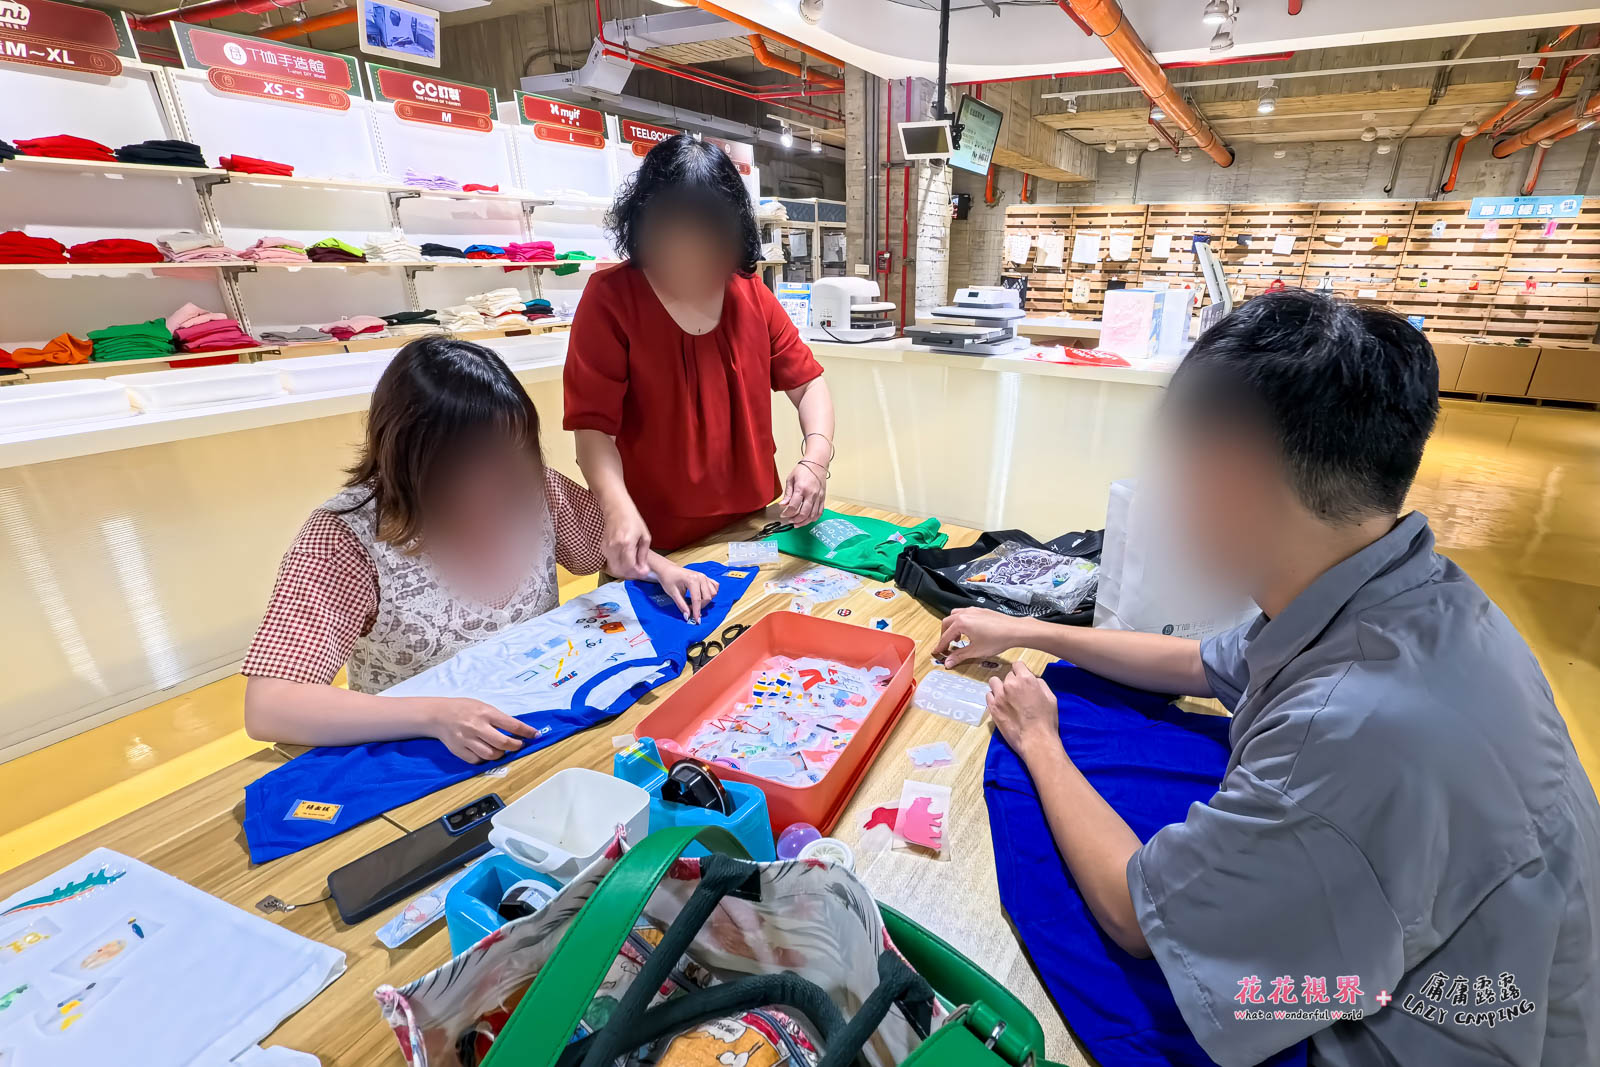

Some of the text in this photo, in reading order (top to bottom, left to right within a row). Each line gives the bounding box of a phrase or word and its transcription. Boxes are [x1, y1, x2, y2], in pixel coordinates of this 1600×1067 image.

[246, 47, 326, 74] T恤手造館
[441, 112, 452, 123] M
